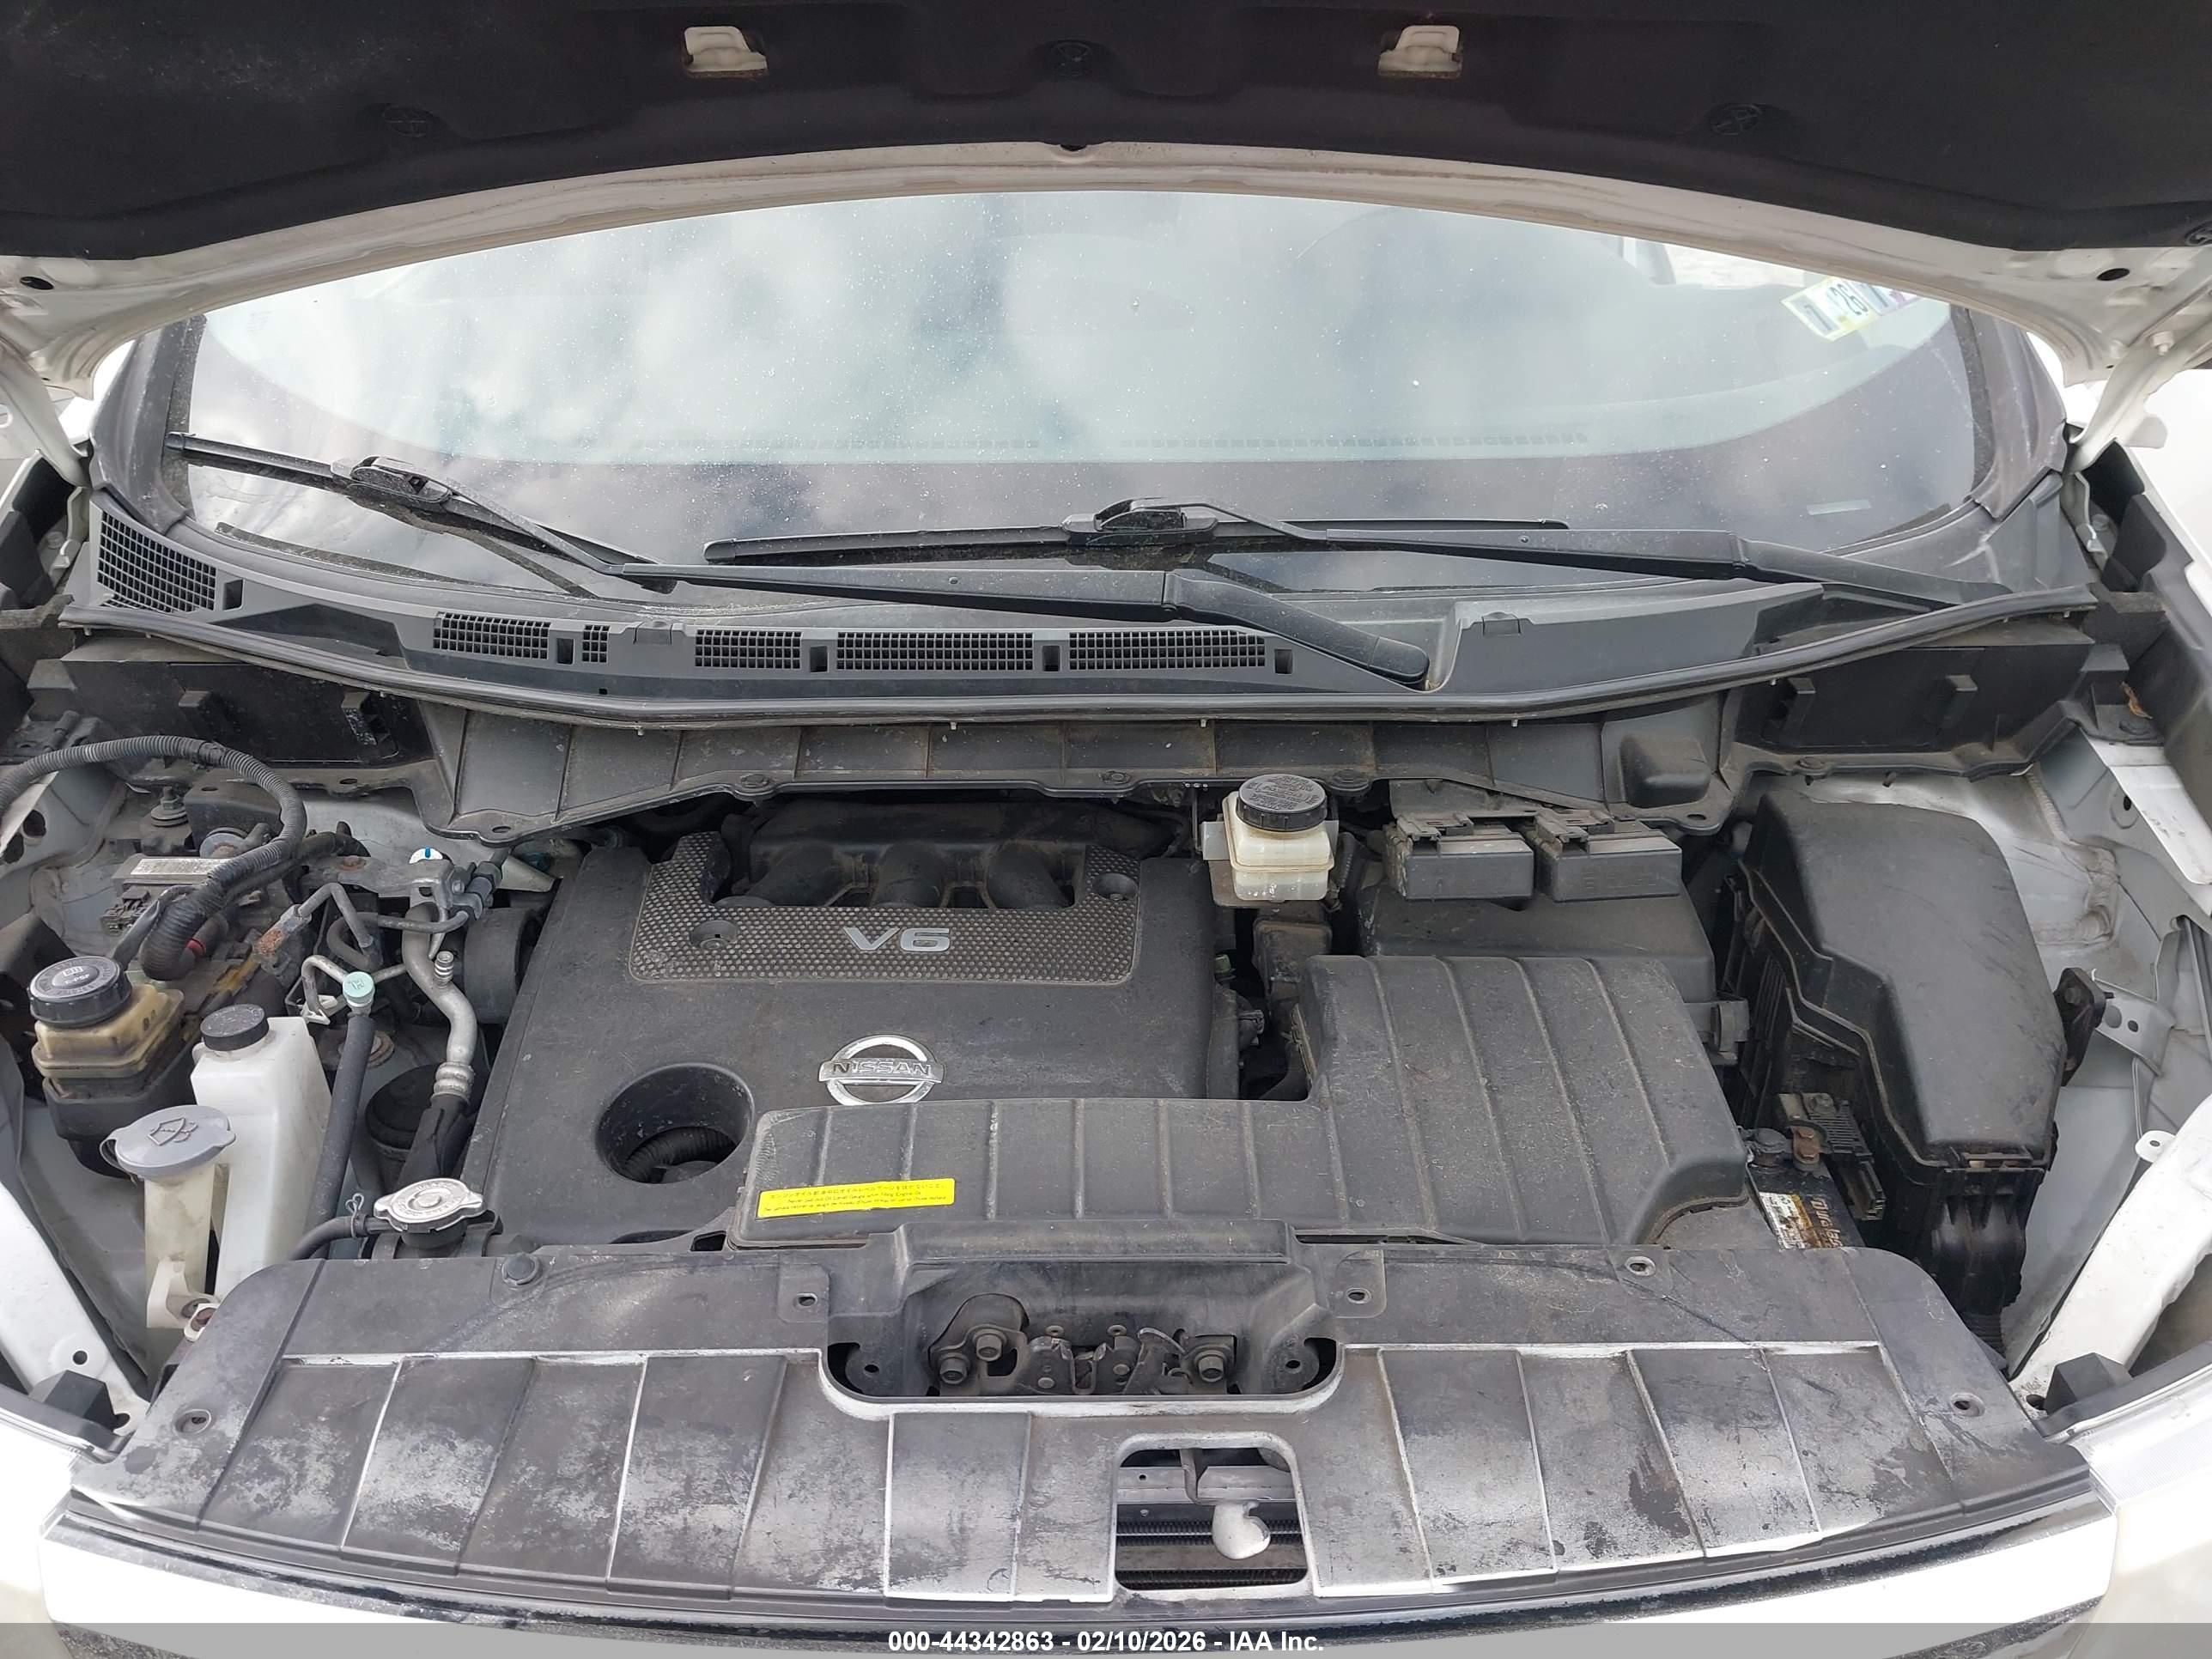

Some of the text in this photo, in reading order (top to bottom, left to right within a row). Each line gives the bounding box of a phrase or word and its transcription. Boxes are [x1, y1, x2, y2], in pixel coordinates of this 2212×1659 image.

[842, 927, 951, 952] V6
[830, 1060, 932, 1076] NISSAN
[1809, 1196, 1844, 1249] Duralas
